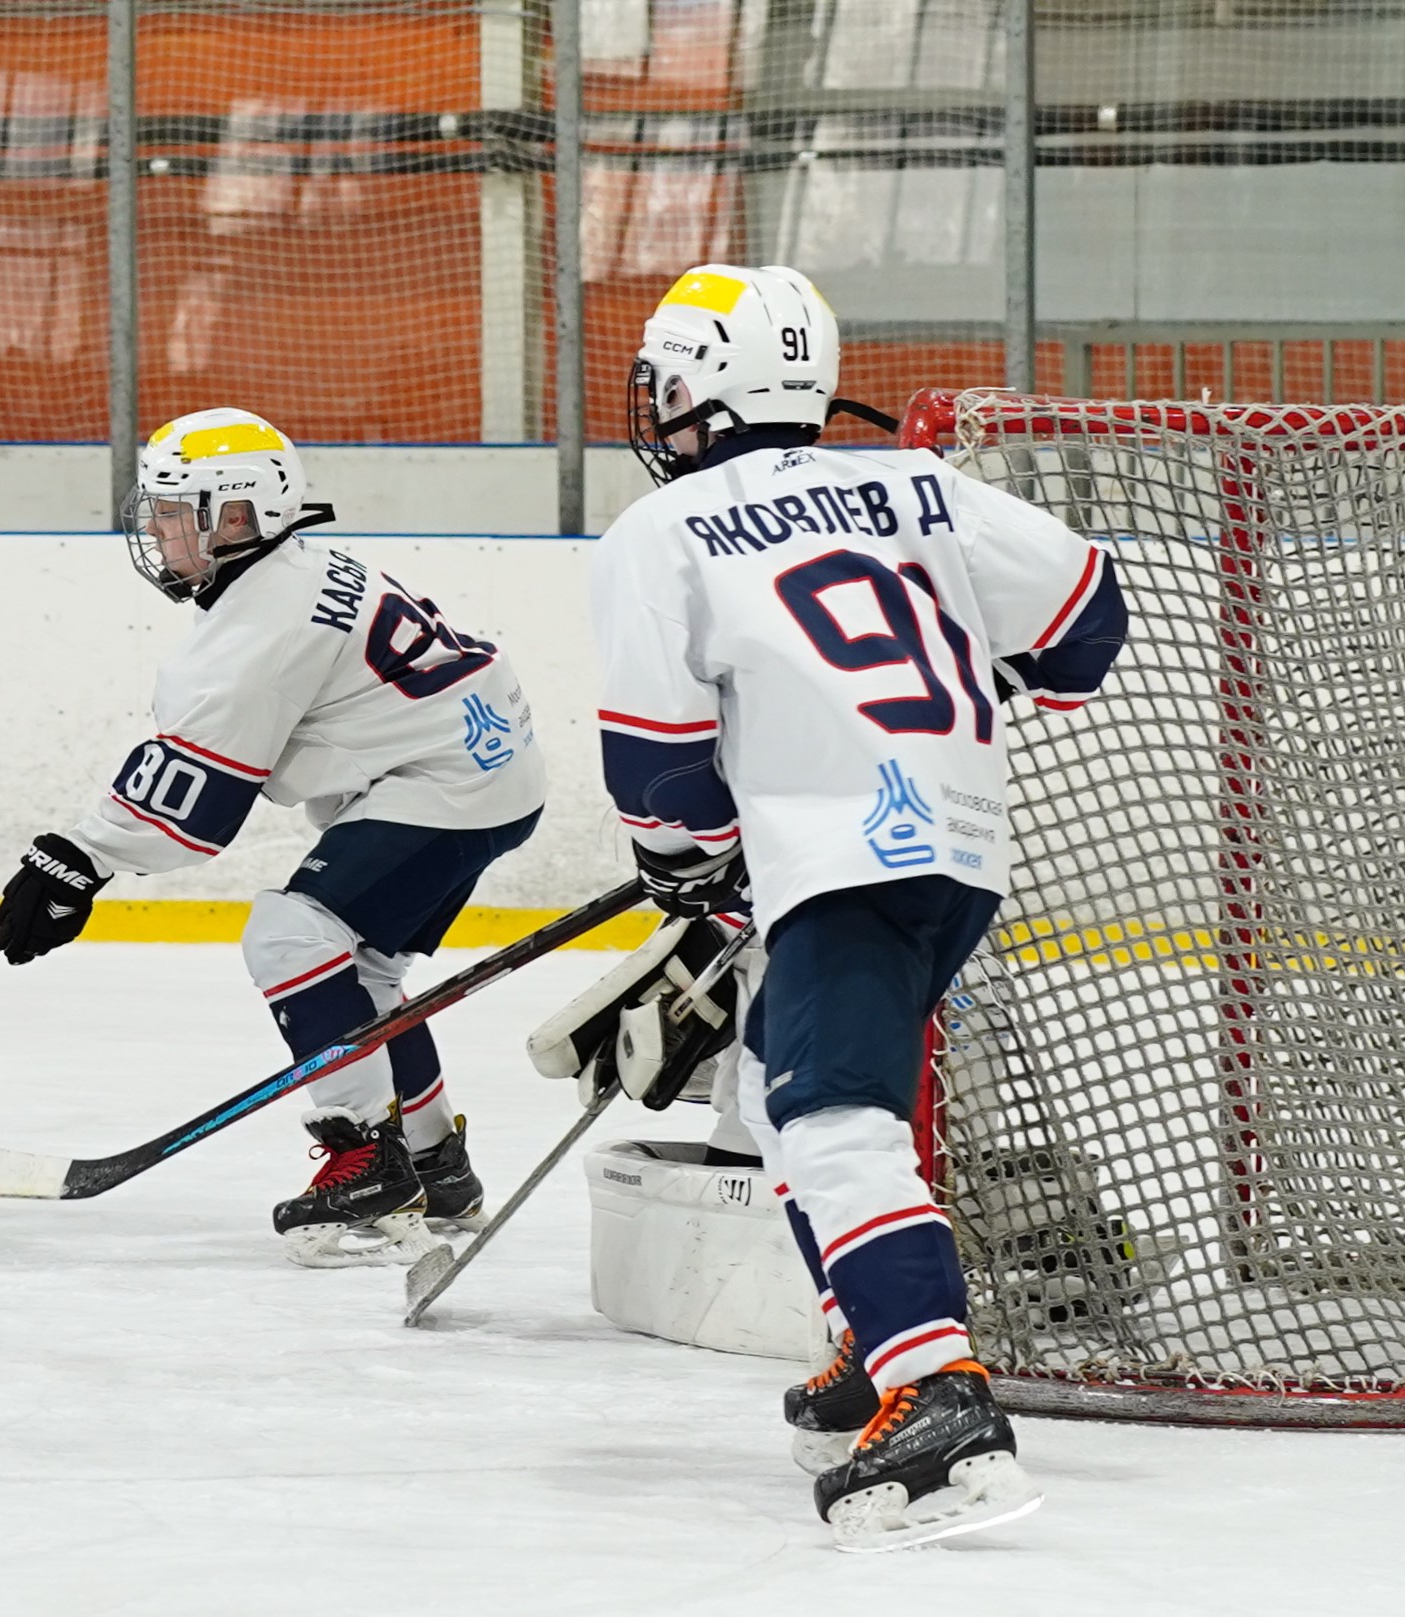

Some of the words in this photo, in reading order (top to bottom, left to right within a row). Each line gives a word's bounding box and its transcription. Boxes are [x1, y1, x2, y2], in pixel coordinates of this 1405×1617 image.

[662, 340, 694, 355] CCM
[782, 327, 810, 361] 91
[218, 481, 257, 492] CCM
[685, 480, 898, 557] ЯКОВЛЕВ
[911, 474, 954, 536] Д
[774, 548, 993, 745] 91
[126, 743, 207, 820] 80
[25, 845, 94, 891] PRIME
